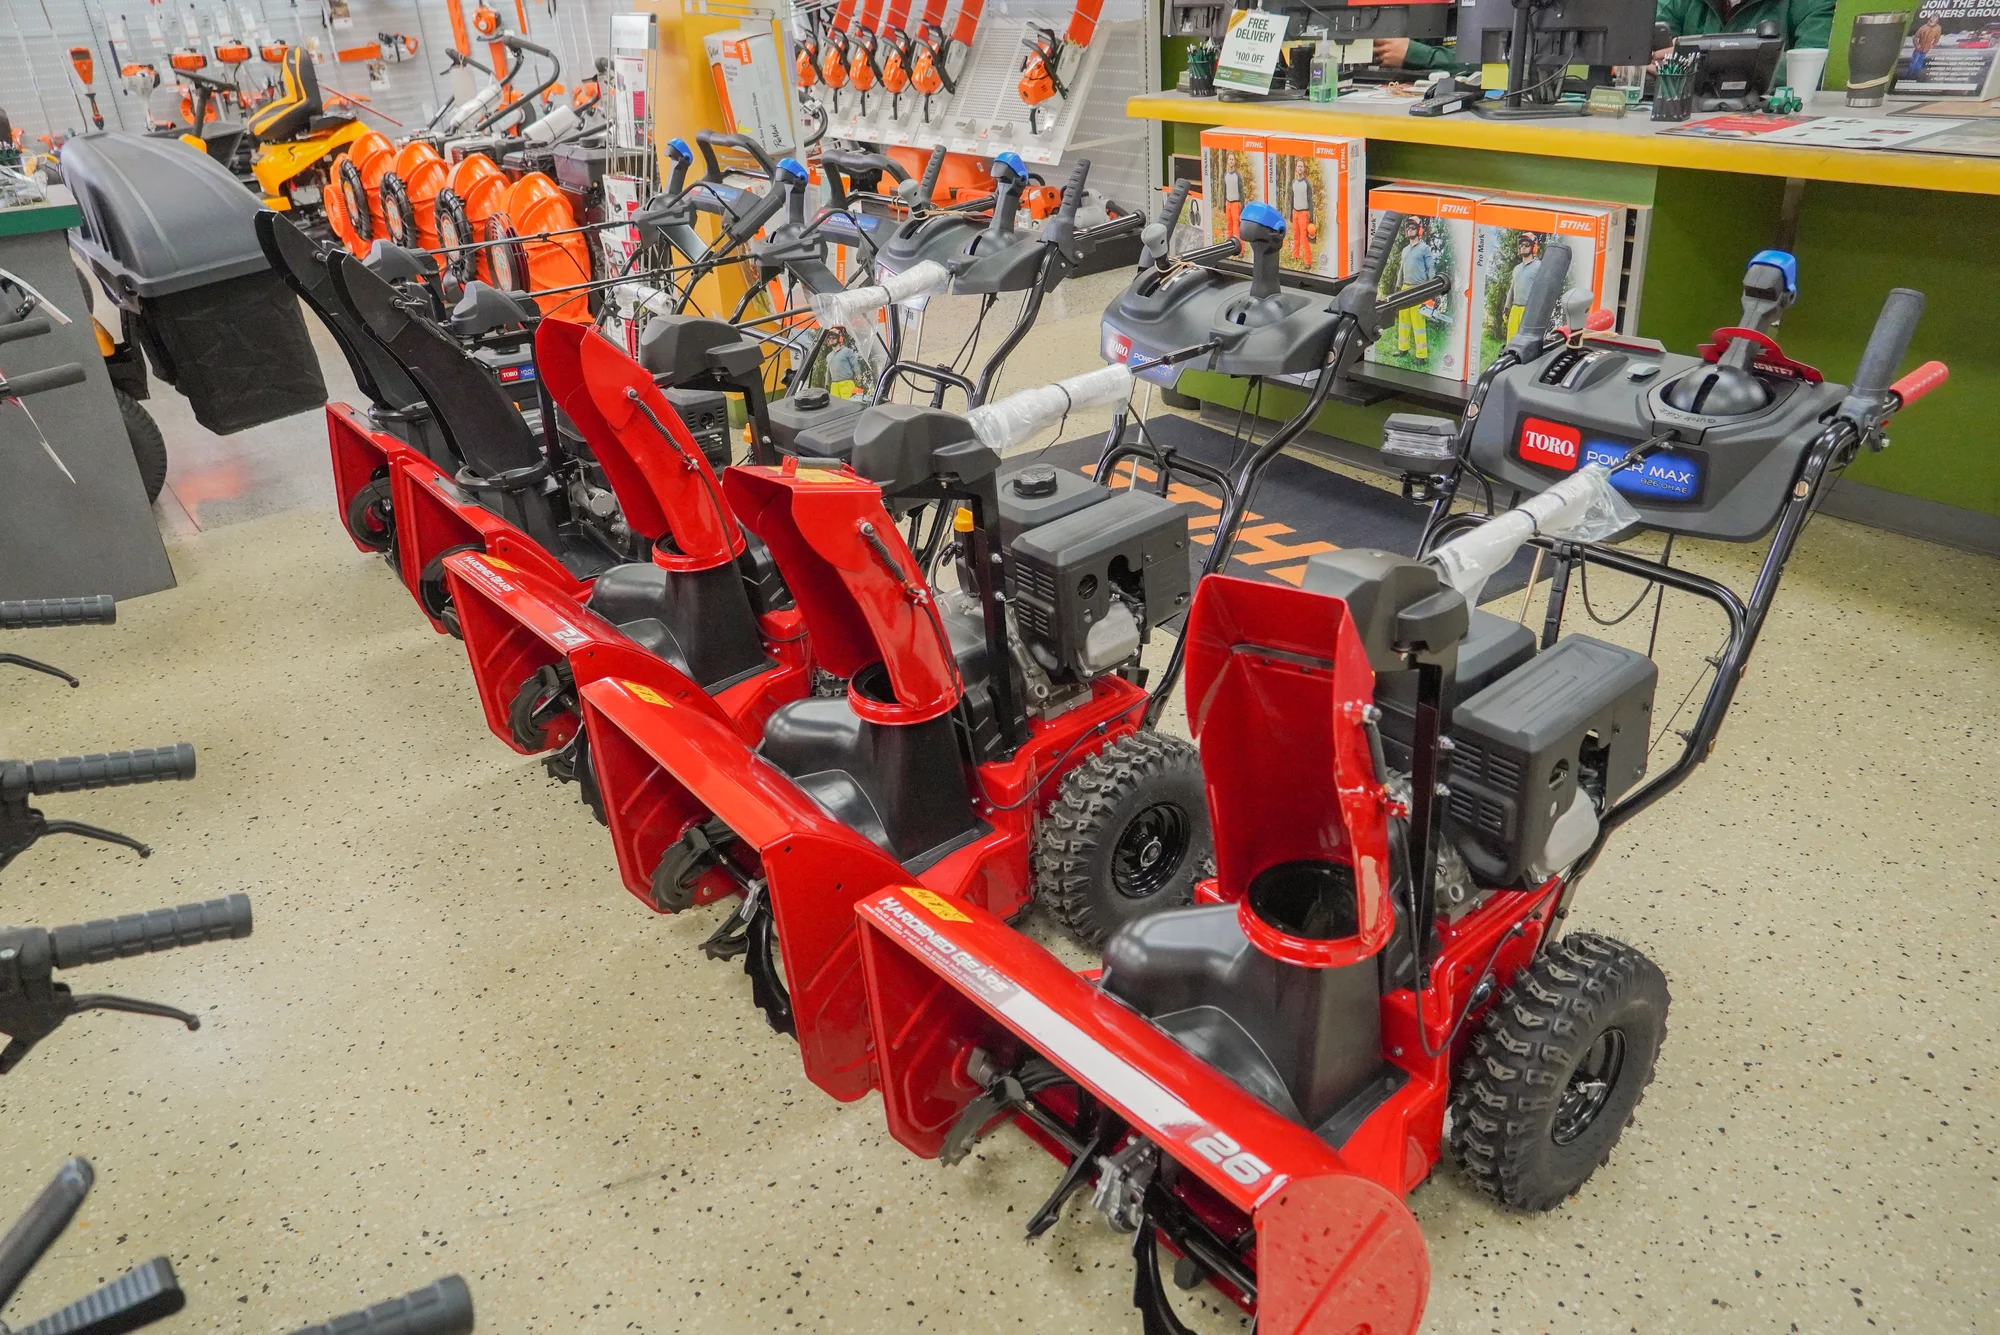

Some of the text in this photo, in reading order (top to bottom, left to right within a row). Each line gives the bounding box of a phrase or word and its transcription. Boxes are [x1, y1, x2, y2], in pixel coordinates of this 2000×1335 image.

[1922, 0, 1948, 9] JOIN
[1953, 0, 1975, 8] THE
[1919, 9, 2000, 19] OWNERS GROU
[1248, 17, 1270, 31] FREE
[1235, 28, 1276, 44] DELIVERY
[1235, 51, 1265, 64] $100 OFF
[1245, 141, 1264, 149] STIHL
[1316, 147, 1336, 156] STIHL
[1440, 203, 1471, 215] STIHL
[1558, 219, 1593, 232] STIHL
[1599, 215, 1608, 248] STIHL
[1526, 430, 1574, 457] TORO
[1586, 450, 1692, 485] POWR MAX
[1640, 477, 1688, 494] 826 OHAE
[552, 628, 589, 647] 24
[874, 906, 889, 920] SOLID
[888, 917, 903, 930] STEEL
[903, 928, 921, 944] SHAFT
[878, 896, 1009, 993] HARDENED GEARS
[1191, 1131, 1273, 1185] 26
